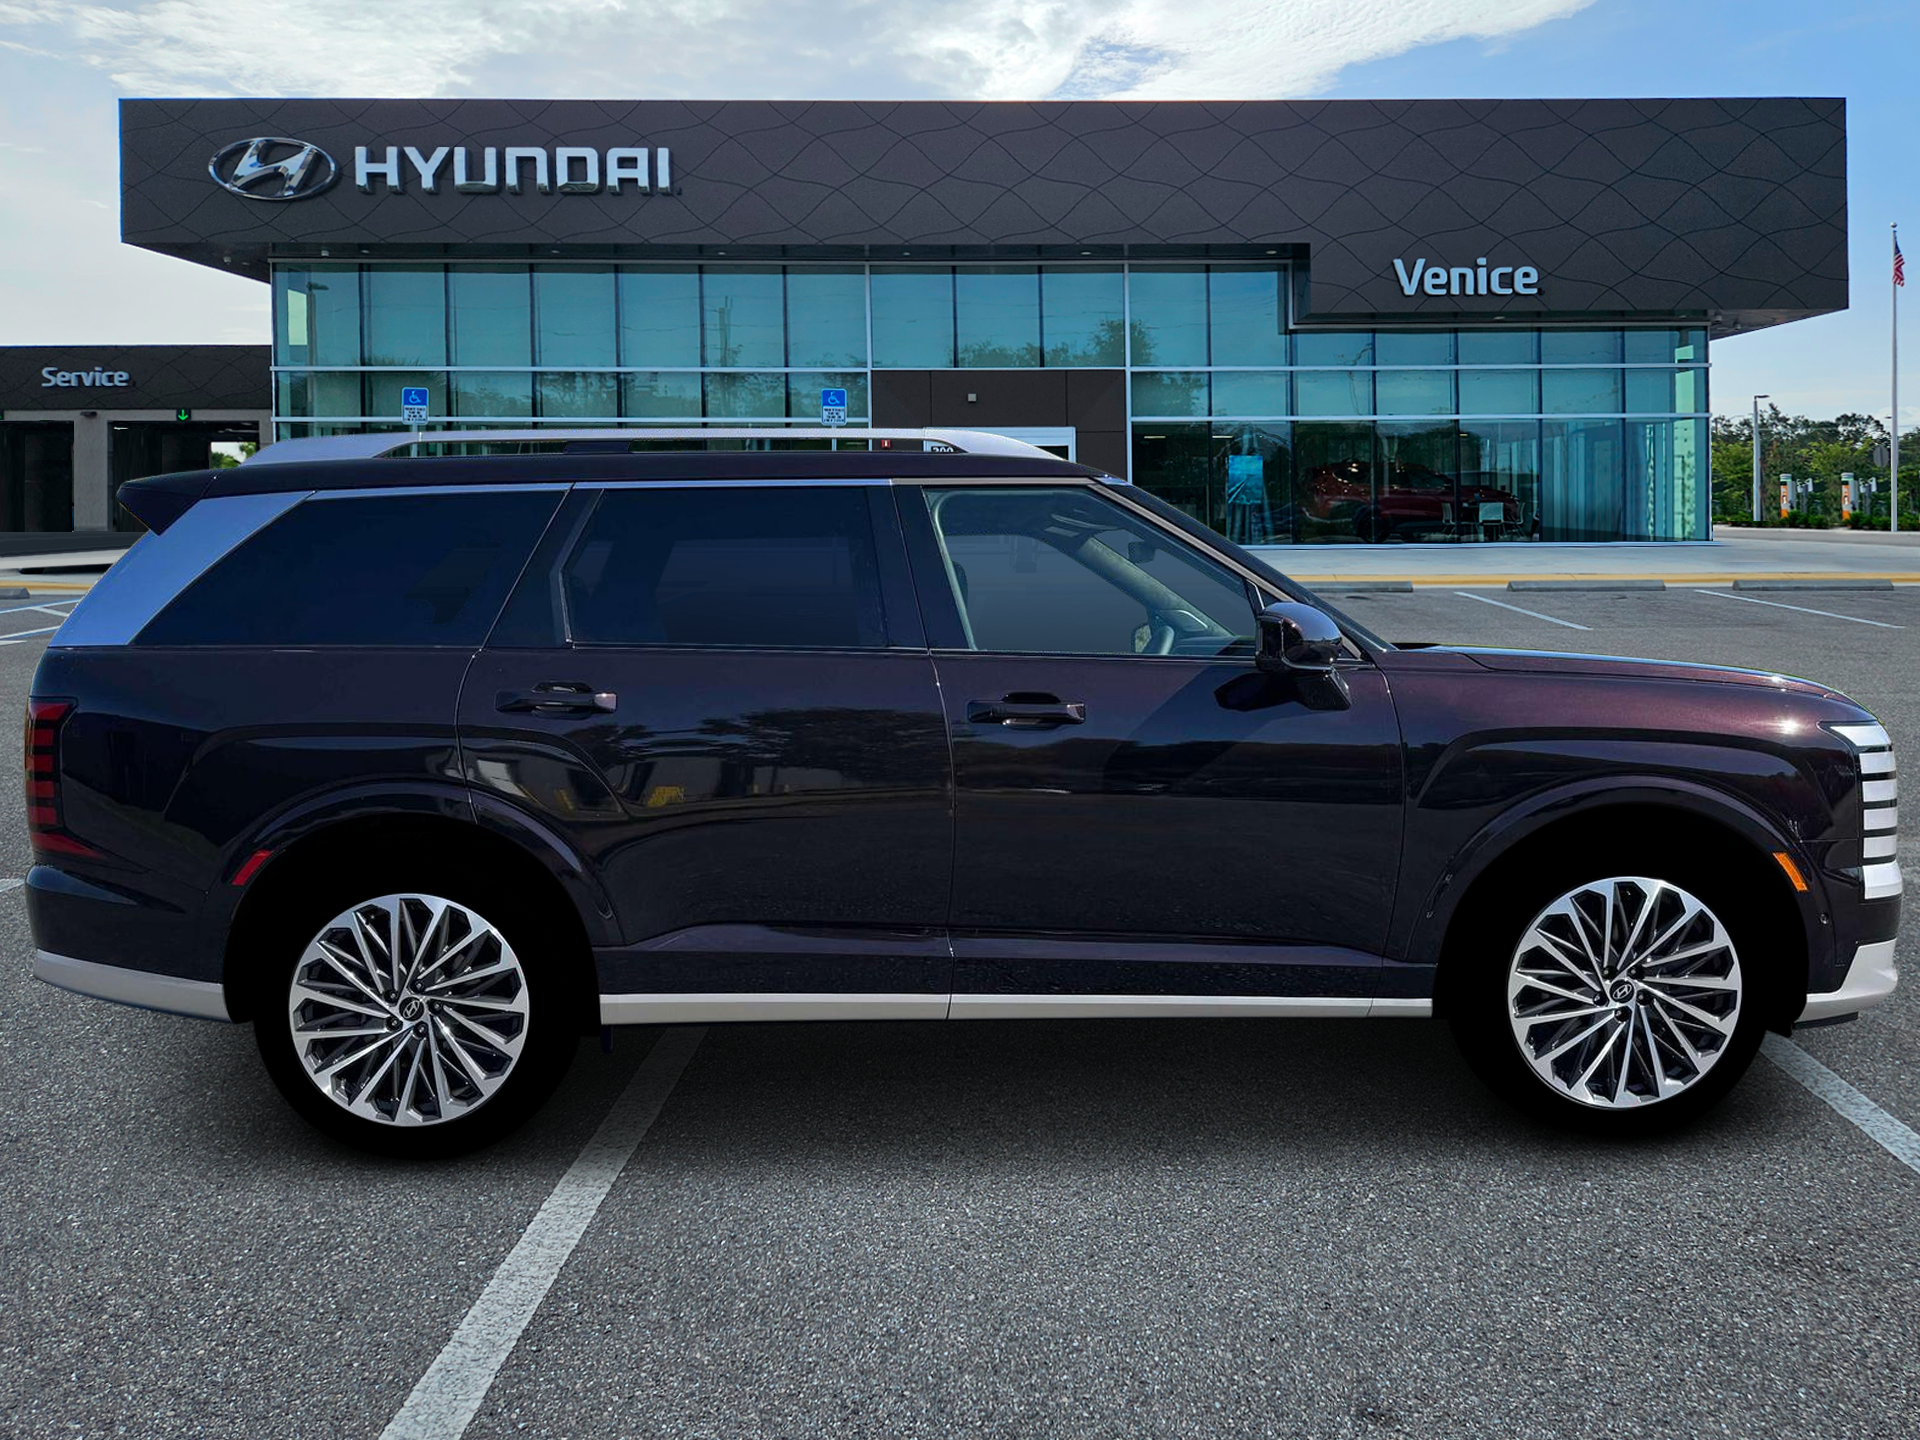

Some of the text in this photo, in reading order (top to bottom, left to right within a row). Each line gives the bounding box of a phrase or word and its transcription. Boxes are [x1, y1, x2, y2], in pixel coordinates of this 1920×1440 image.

[354, 146, 671, 194] HYUNDAI
[1392, 257, 1539, 295] Venice
[41, 366, 130, 388] Service
